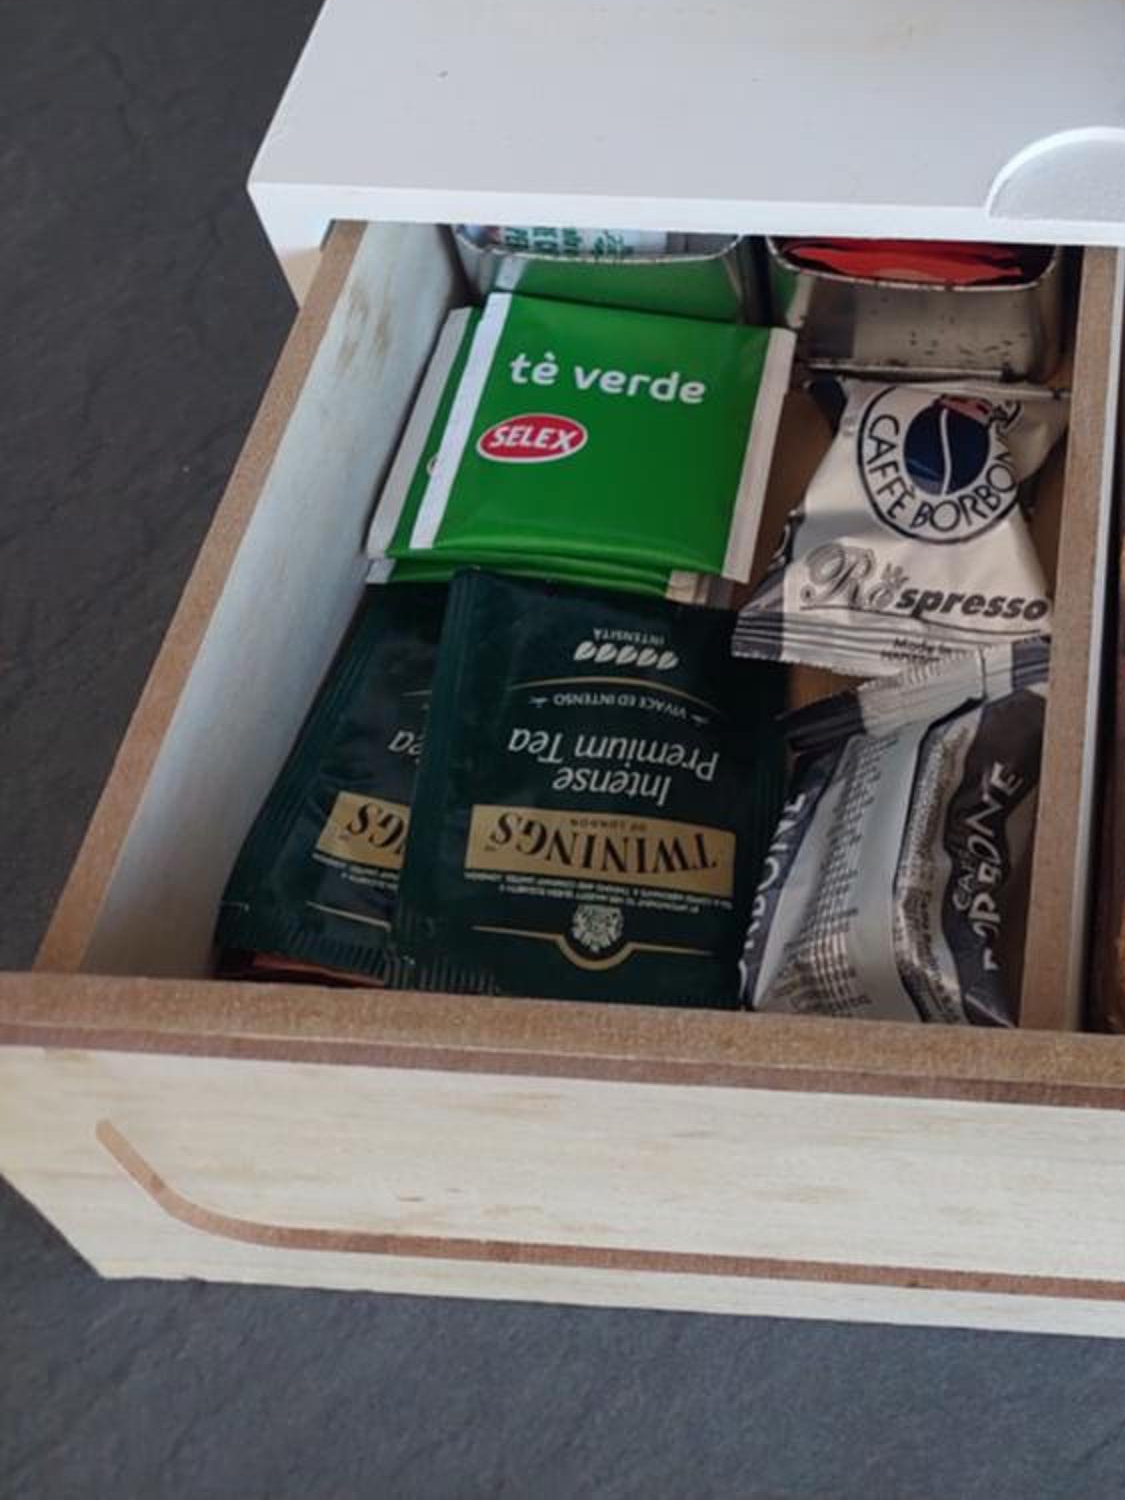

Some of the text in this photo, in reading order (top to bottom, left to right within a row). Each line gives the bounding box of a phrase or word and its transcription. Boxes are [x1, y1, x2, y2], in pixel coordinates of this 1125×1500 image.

[508, 351, 706, 405] tè verde
[488, 424, 579, 453] SELEX
[552, 691, 688, 720] VIVACE ED INTENSO
[507, 726, 721, 781] Premium Tea
[551, 766, 673, 806] Intense
[488, 812, 718, 875] TWININGS
